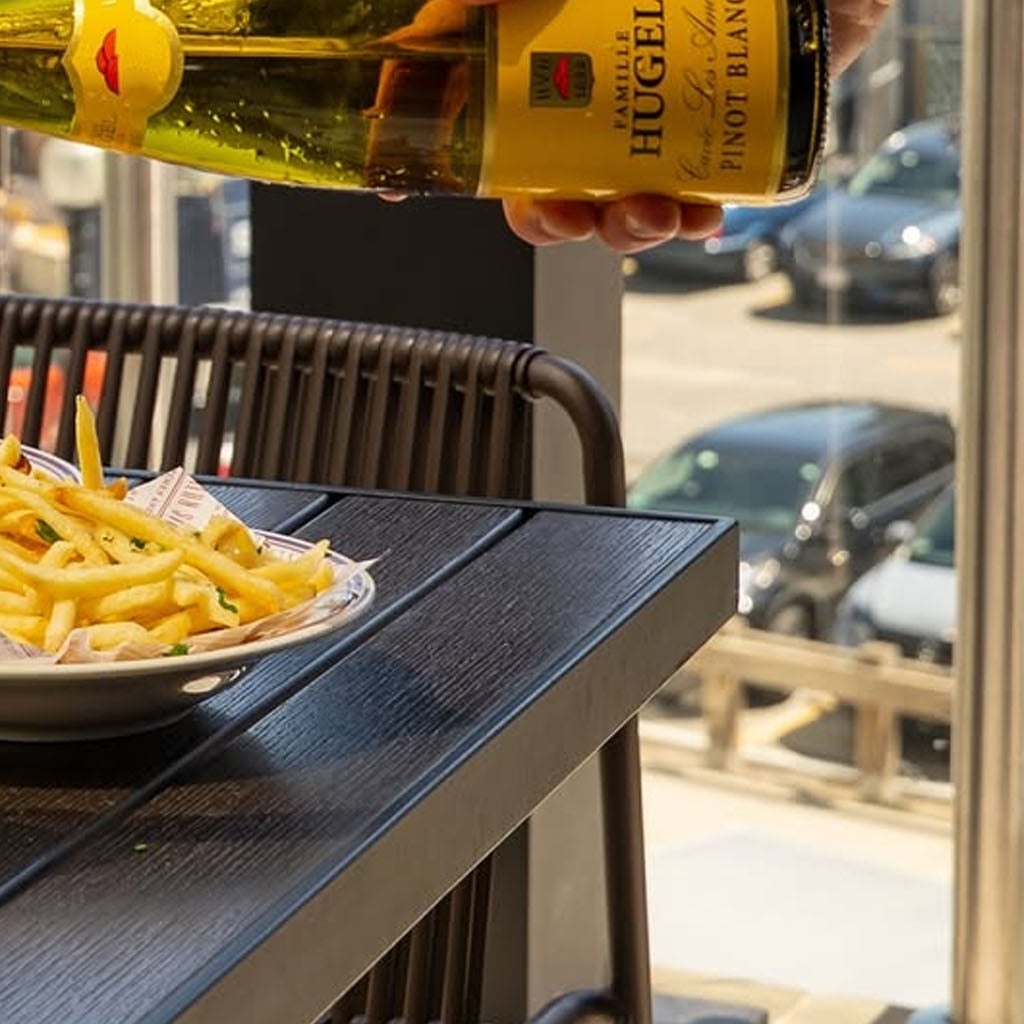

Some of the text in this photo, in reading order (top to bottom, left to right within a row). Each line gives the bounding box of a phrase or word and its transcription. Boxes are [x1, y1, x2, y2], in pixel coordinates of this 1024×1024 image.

[614, 30, 630, 130] FAMILLE
[682, 67, 716, 118] Les
[720, 90, 749, 170] PINOT
